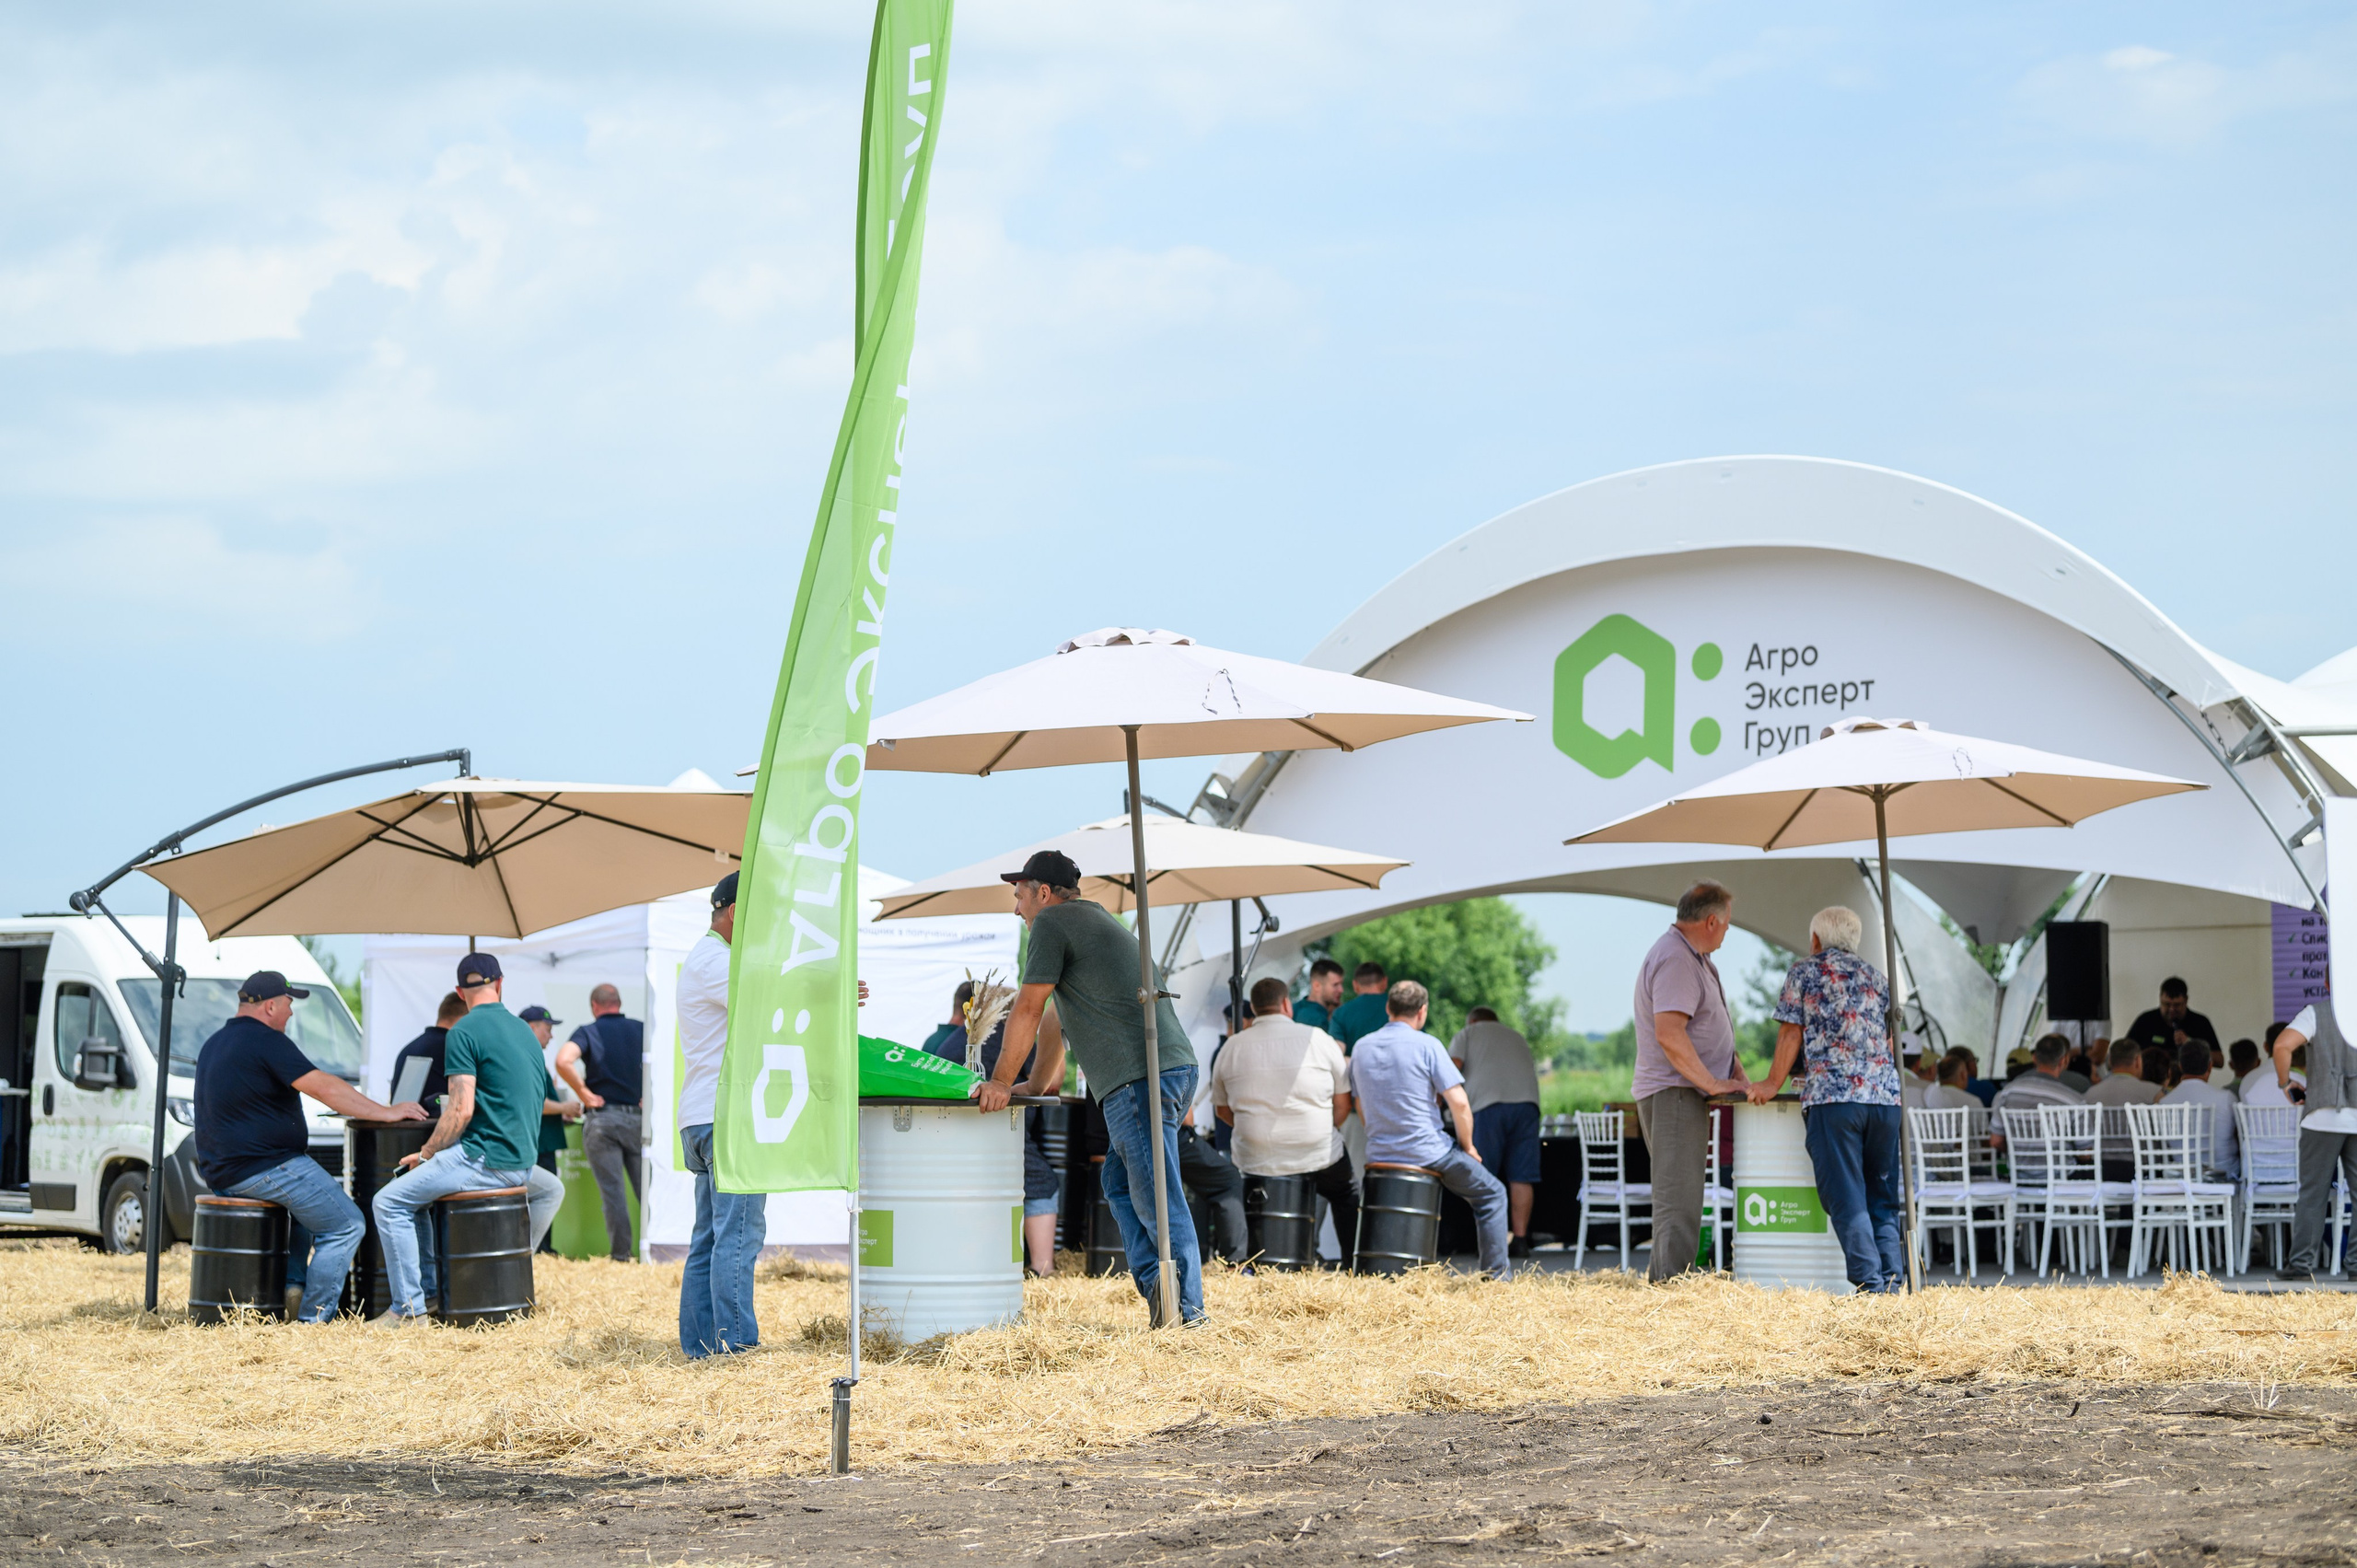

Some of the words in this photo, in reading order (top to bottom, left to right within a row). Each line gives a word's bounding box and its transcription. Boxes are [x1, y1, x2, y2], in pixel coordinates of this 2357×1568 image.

[1745, 643, 1819, 676] Агро
[1745, 679, 1875, 711] Эксперт
[1745, 721, 1811, 756] Груп
[1780, 1201, 1798, 1209] Агро
[1780, 1216, 1797, 1225] Груп
